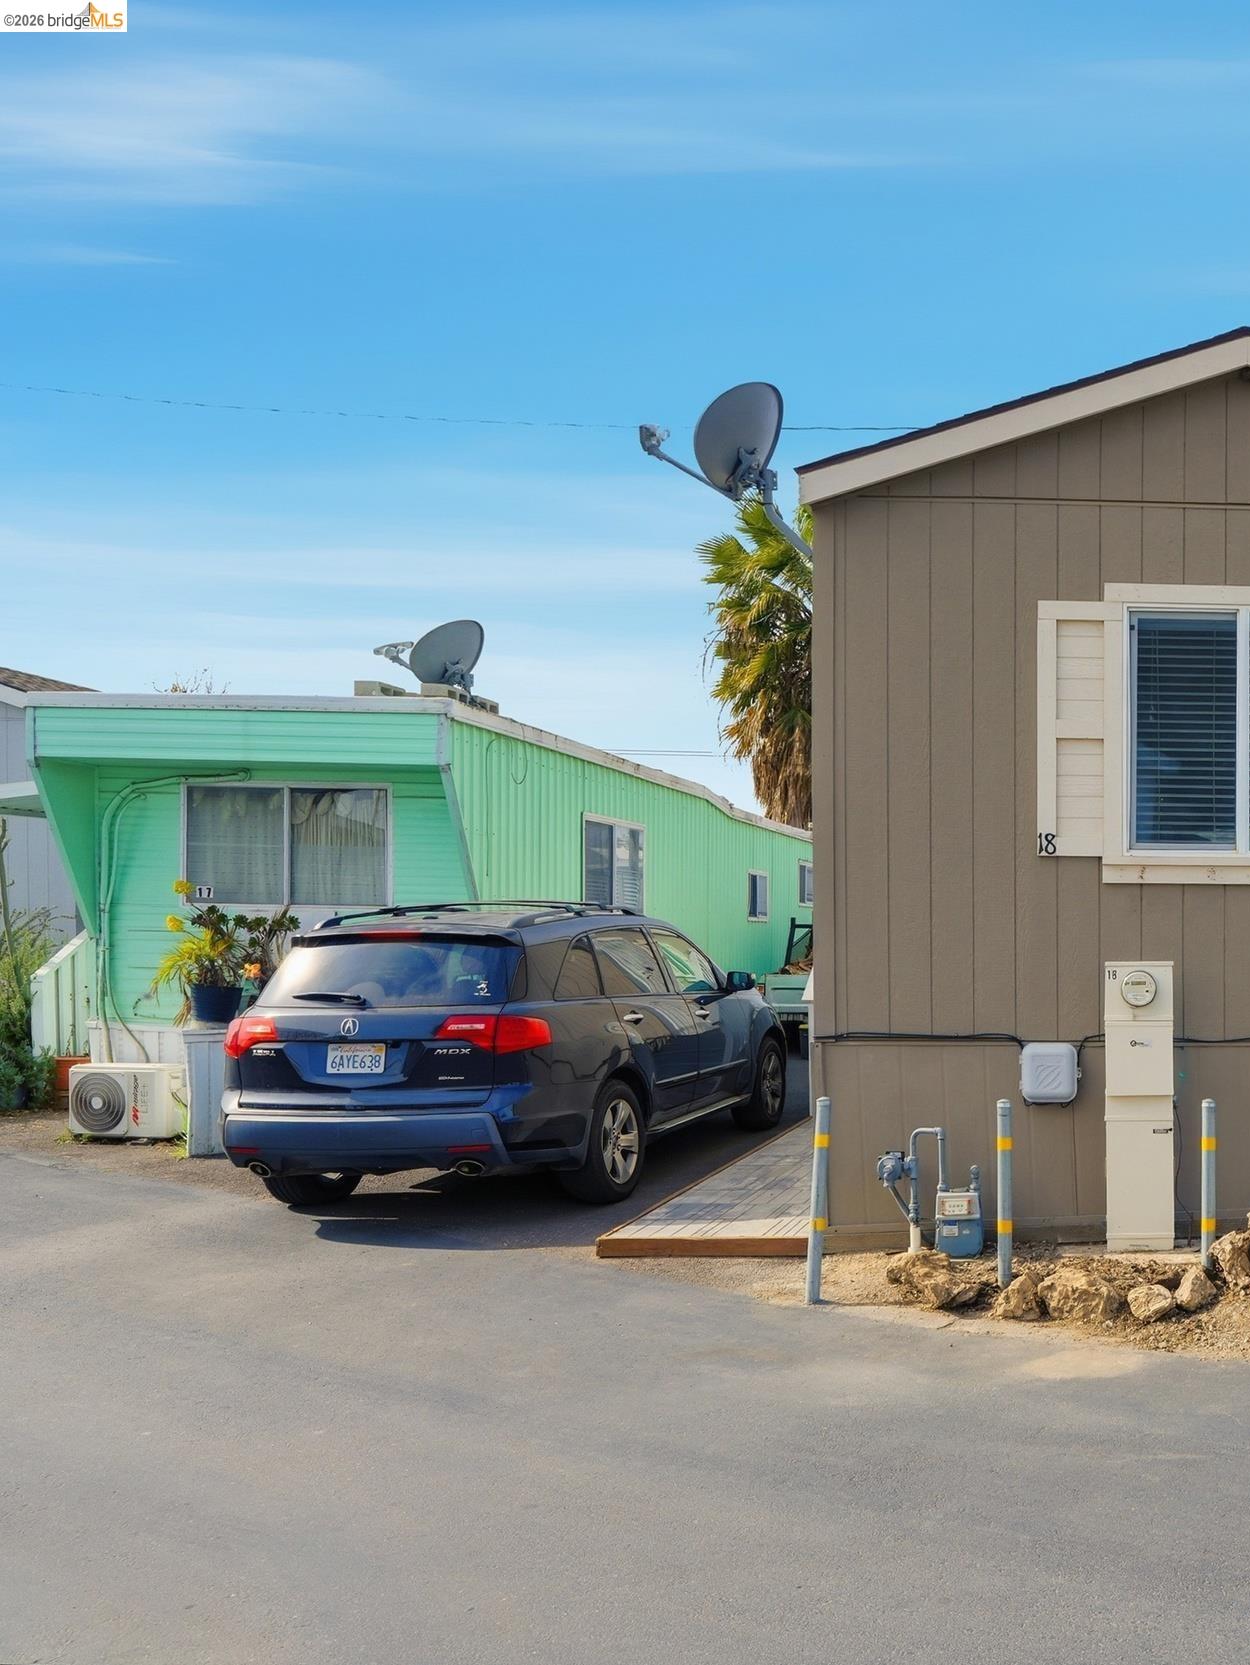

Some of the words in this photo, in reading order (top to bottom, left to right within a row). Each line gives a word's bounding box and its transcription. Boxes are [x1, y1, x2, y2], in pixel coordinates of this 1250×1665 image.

[1038, 832, 1057, 855] 18
[198, 887, 212, 898] 17
[1107, 969, 1118, 980] 18
[330, 1054, 382, 1069] 6AYE638
